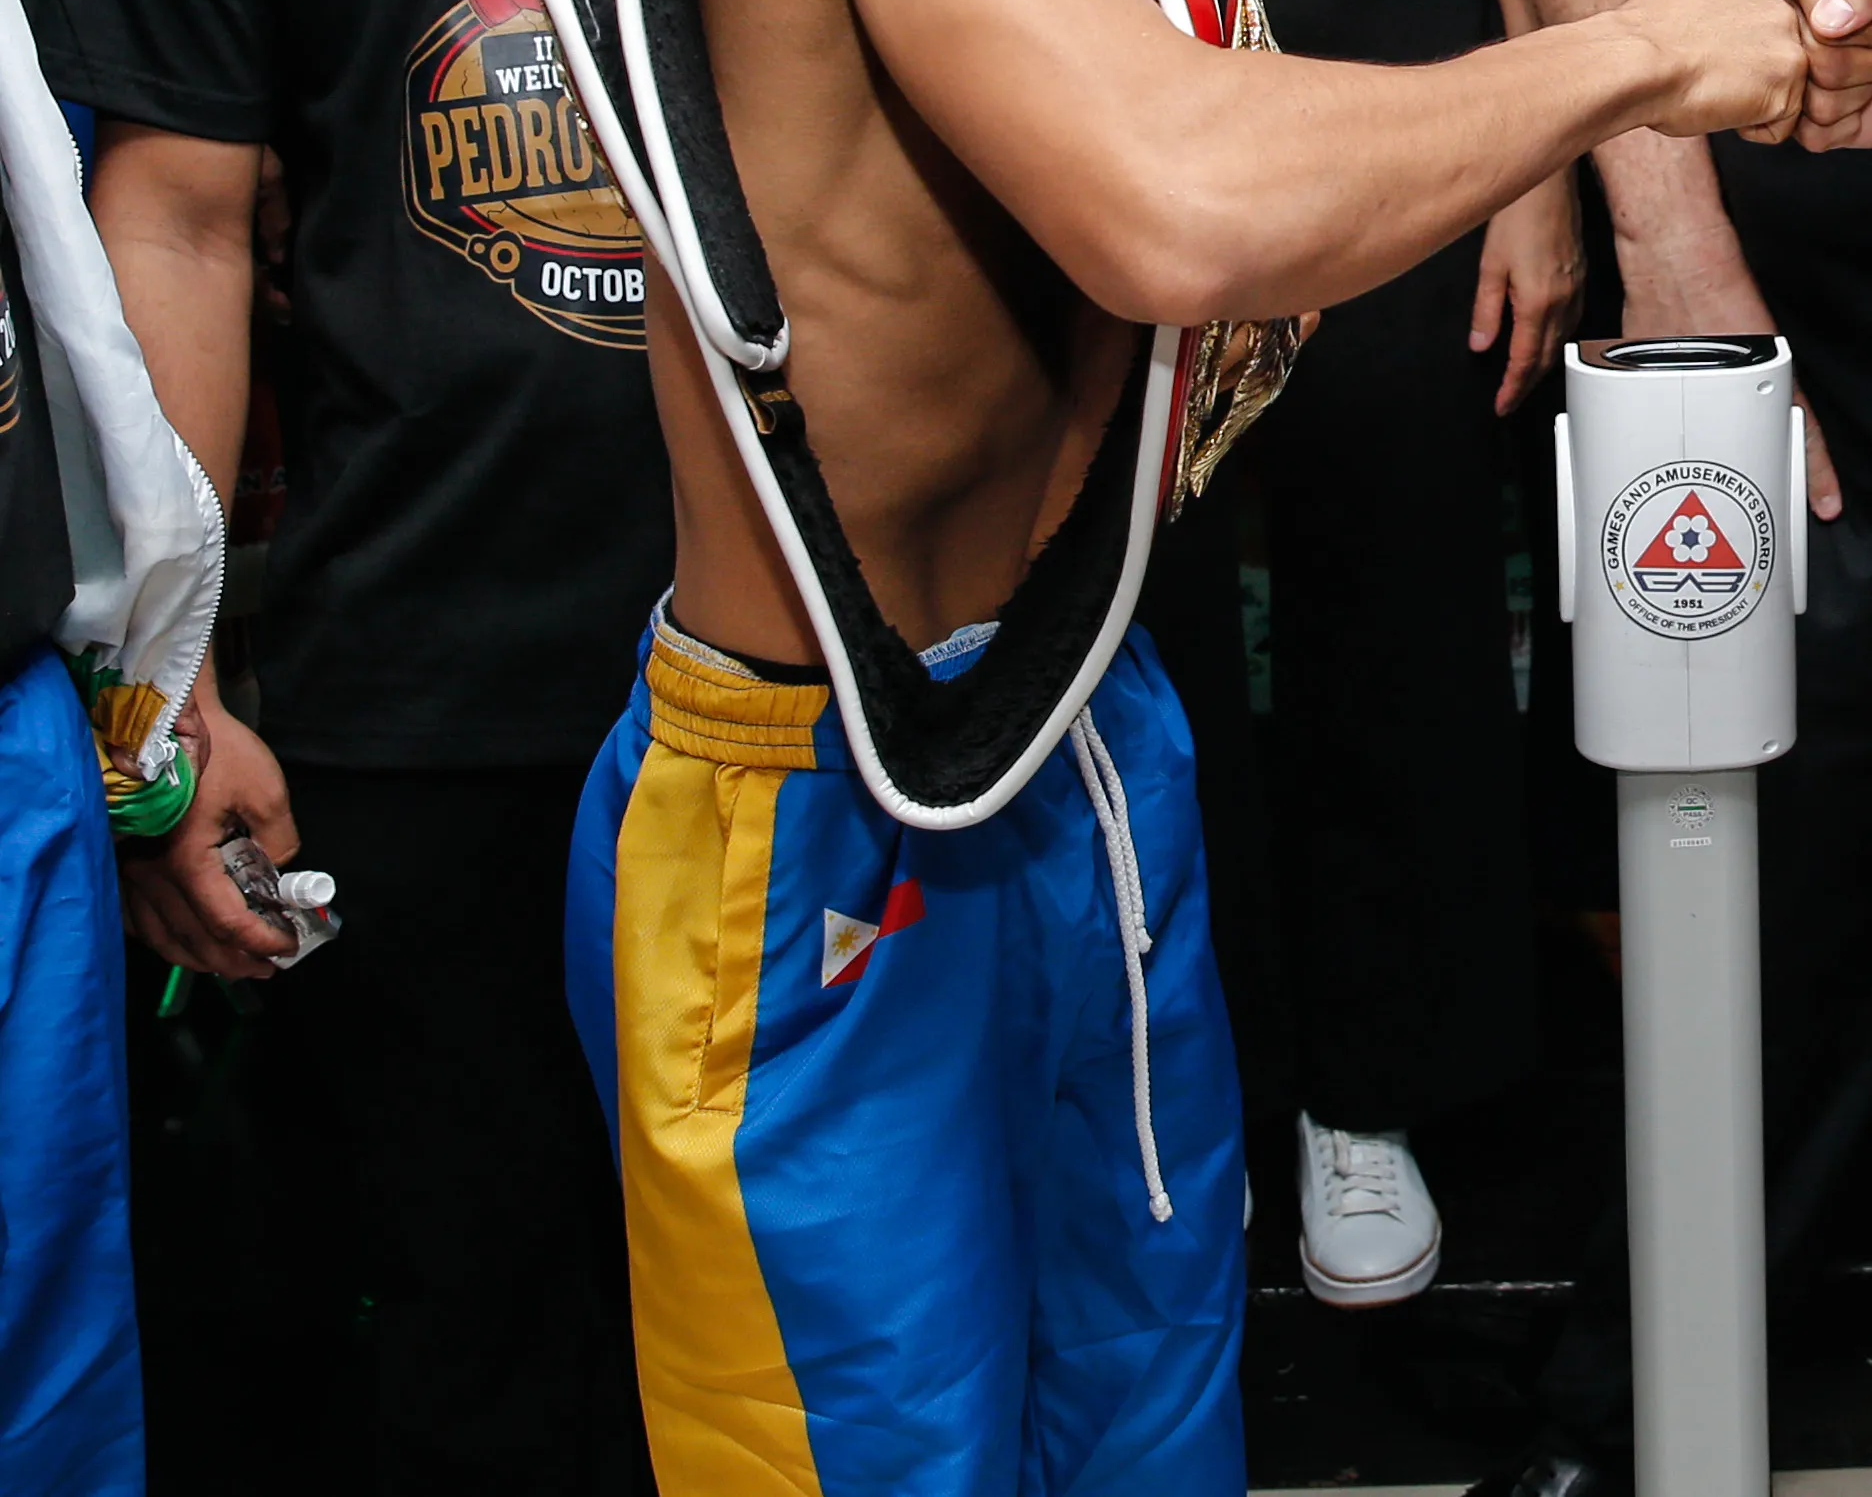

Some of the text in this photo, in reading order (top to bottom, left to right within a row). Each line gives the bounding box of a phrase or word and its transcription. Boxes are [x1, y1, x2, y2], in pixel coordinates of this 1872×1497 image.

[420, 97, 595, 202] PEDRO
[540, 261, 645, 303] OCTOB
[1608, 466, 1770, 571] GAMES AND AMUSEMENTS BOARD
[1628, 598, 1750, 632] OFFICE OF THE PRESIDENT
[1672, 598, 1704, 610] 1951
